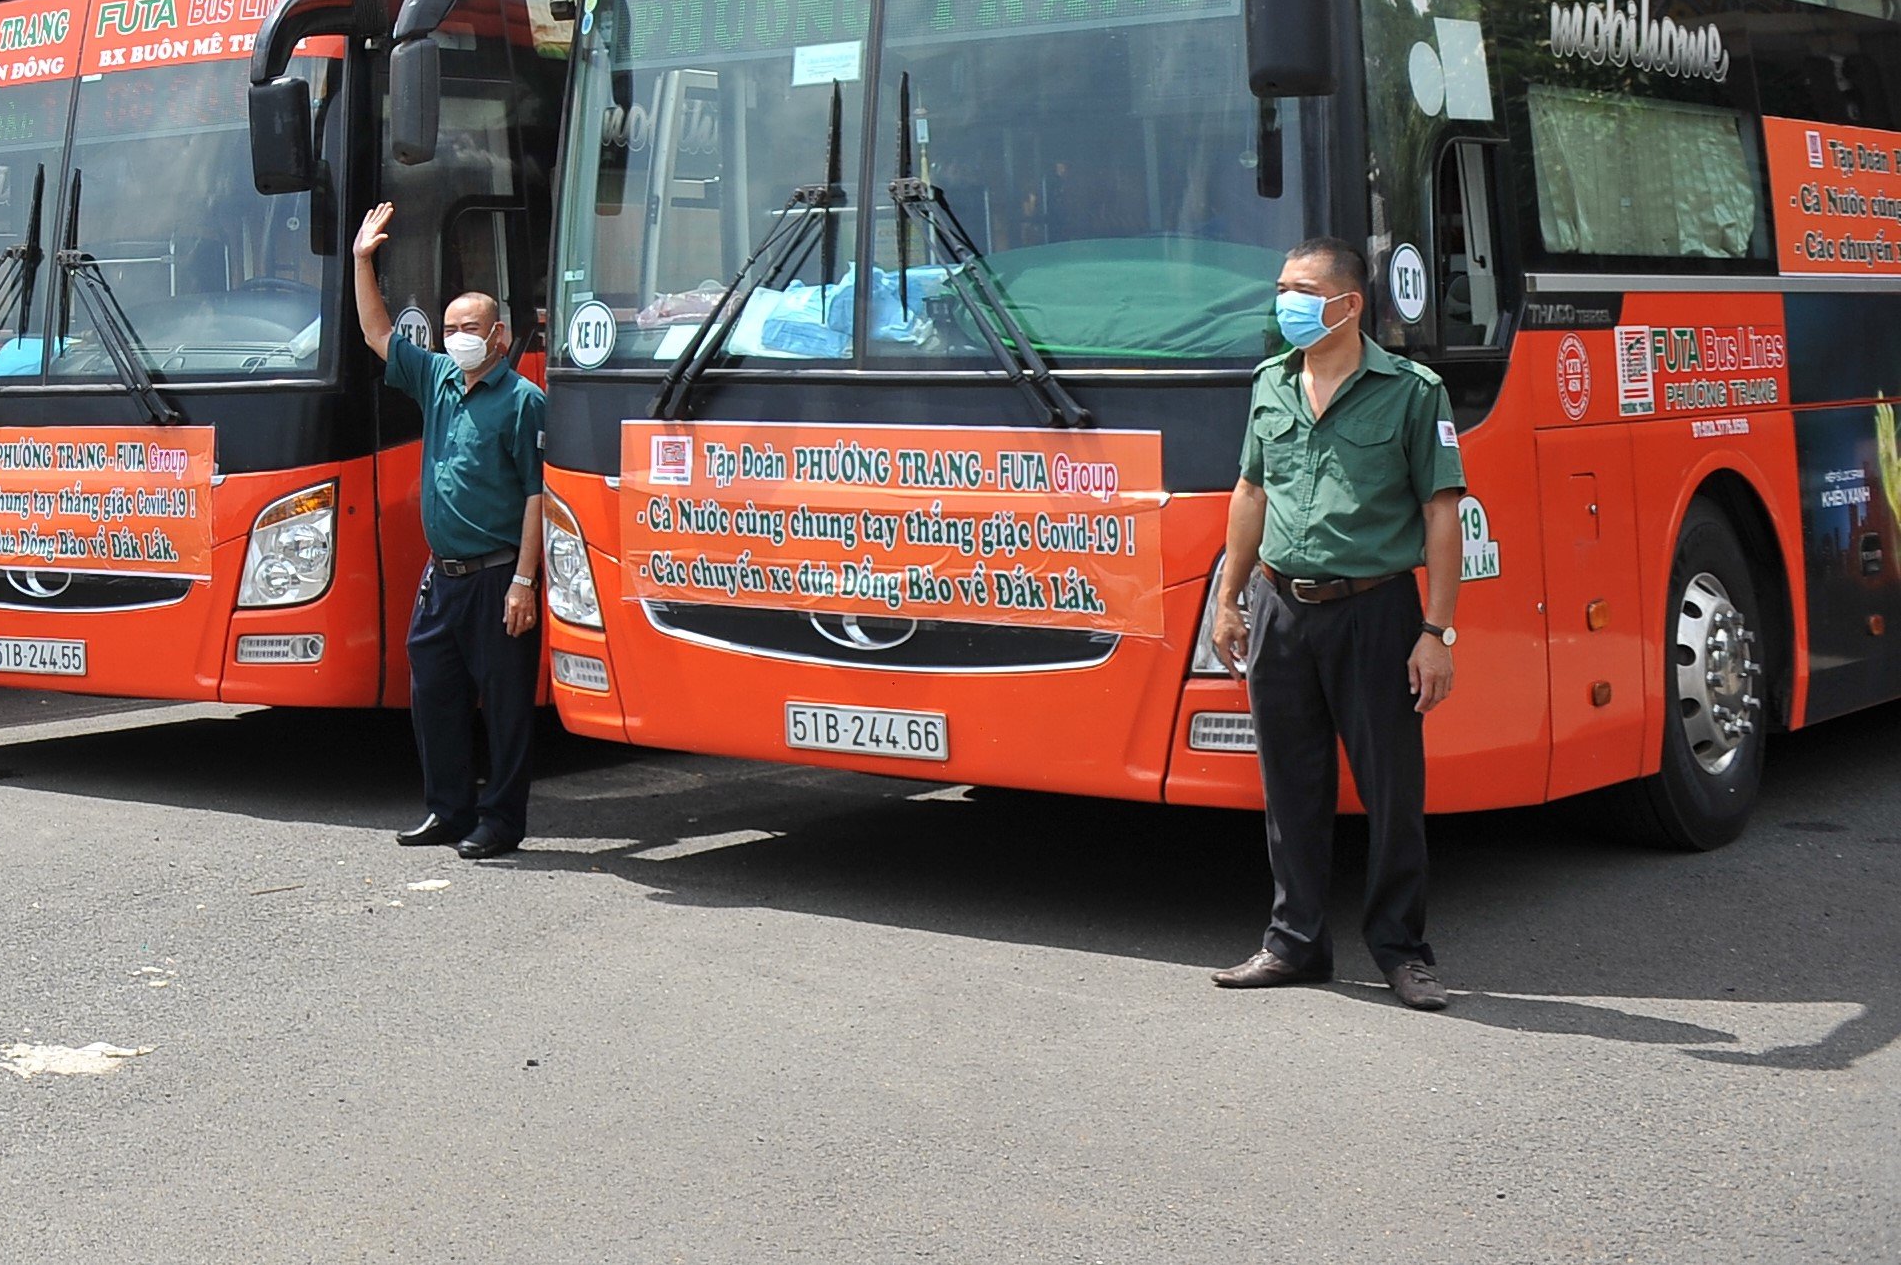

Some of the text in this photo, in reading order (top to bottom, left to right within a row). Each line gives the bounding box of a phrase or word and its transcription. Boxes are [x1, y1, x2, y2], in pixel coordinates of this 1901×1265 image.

[0, 9, 70, 52] TRANG
[99, 32, 223, 67] BX BUÔN MÊ
[11, 56, 64, 80] ĐÔNG
[1397, 266, 1422, 301] XE 01
[415, 327, 426, 347] 02
[576, 320, 607, 350] XE 01
[1650, 326, 1785, 373] FUTA Bus Lines
[1665, 377, 1778, 411] PHƯƠNG TRANG
[56, 443, 106, 472] TRANG
[115, 443, 146, 472] FUTA
[148, 442, 188, 480] Group
[704, 439, 1118, 502] Tập Đoàn PHƯƠNG TRANG FUTA Group
[32, 489, 55, 520] tay
[58, 480, 100, 523] thắng
[102, 487, 133, 522] giặc
[136, 488, 187, 519] Covid-19
[18, 523, 56, 563] Đồng
[57, 530, 88, 556] Bào
[89, 525, 107, 558] về
[109, 527, 142, 561] Đắk
[143, 527, 179, 563] Lắk.
[649, 495, 1121, 558] Cả Nước cùng chung tay thắng giặc Covid-19
[1475, 544, 1497, 577] LẮK
[650, 550, 1105, 615] Các chuyến xe đưa Đồng Bào về Đắk Lắk.
[792, 710, 940, 753] 51B-244.66
